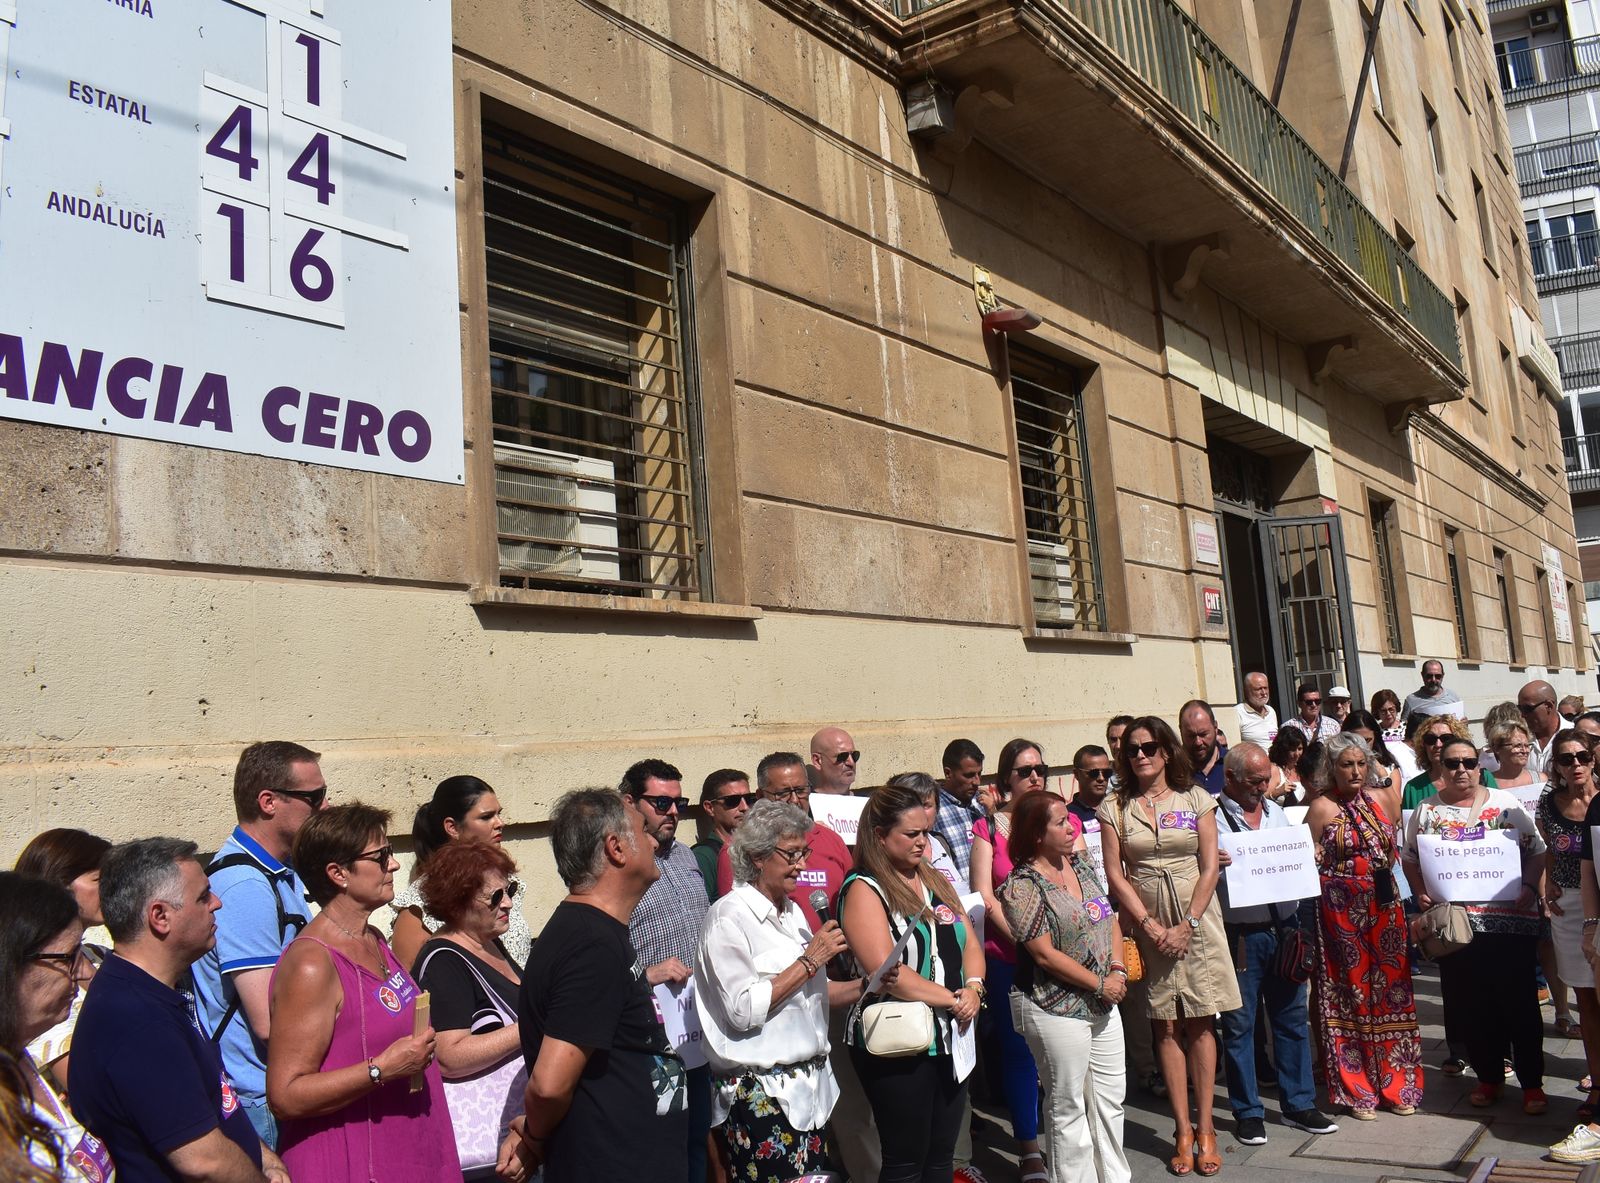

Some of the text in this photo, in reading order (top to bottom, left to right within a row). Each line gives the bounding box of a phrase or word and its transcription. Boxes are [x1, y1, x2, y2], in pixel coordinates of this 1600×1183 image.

[295, 33, 320, 107] 1
[69, 80, 152, 125] ESTATAL
[47, 191, 165, 239] ANDALUCÍA
[262, 386, 432, 463] CERO
[1205, 592, 1220, 611] CNT
[1181, 811, 1197, 822] UGT
[1464, 826, 1481, 835] UGT
[1236, 841, 1310, 856] Si te amenazan,
[1434, 846, 1505, 857] Si te pegan,
[1251, 863, 1303, 876] no es amor
[1438, 870, 1504, 880] no es amor
[389, 971, 405, 989] UGT
[678, 996, 692, 1012] Ni
[83, 1131, 101, 1154] UGT
